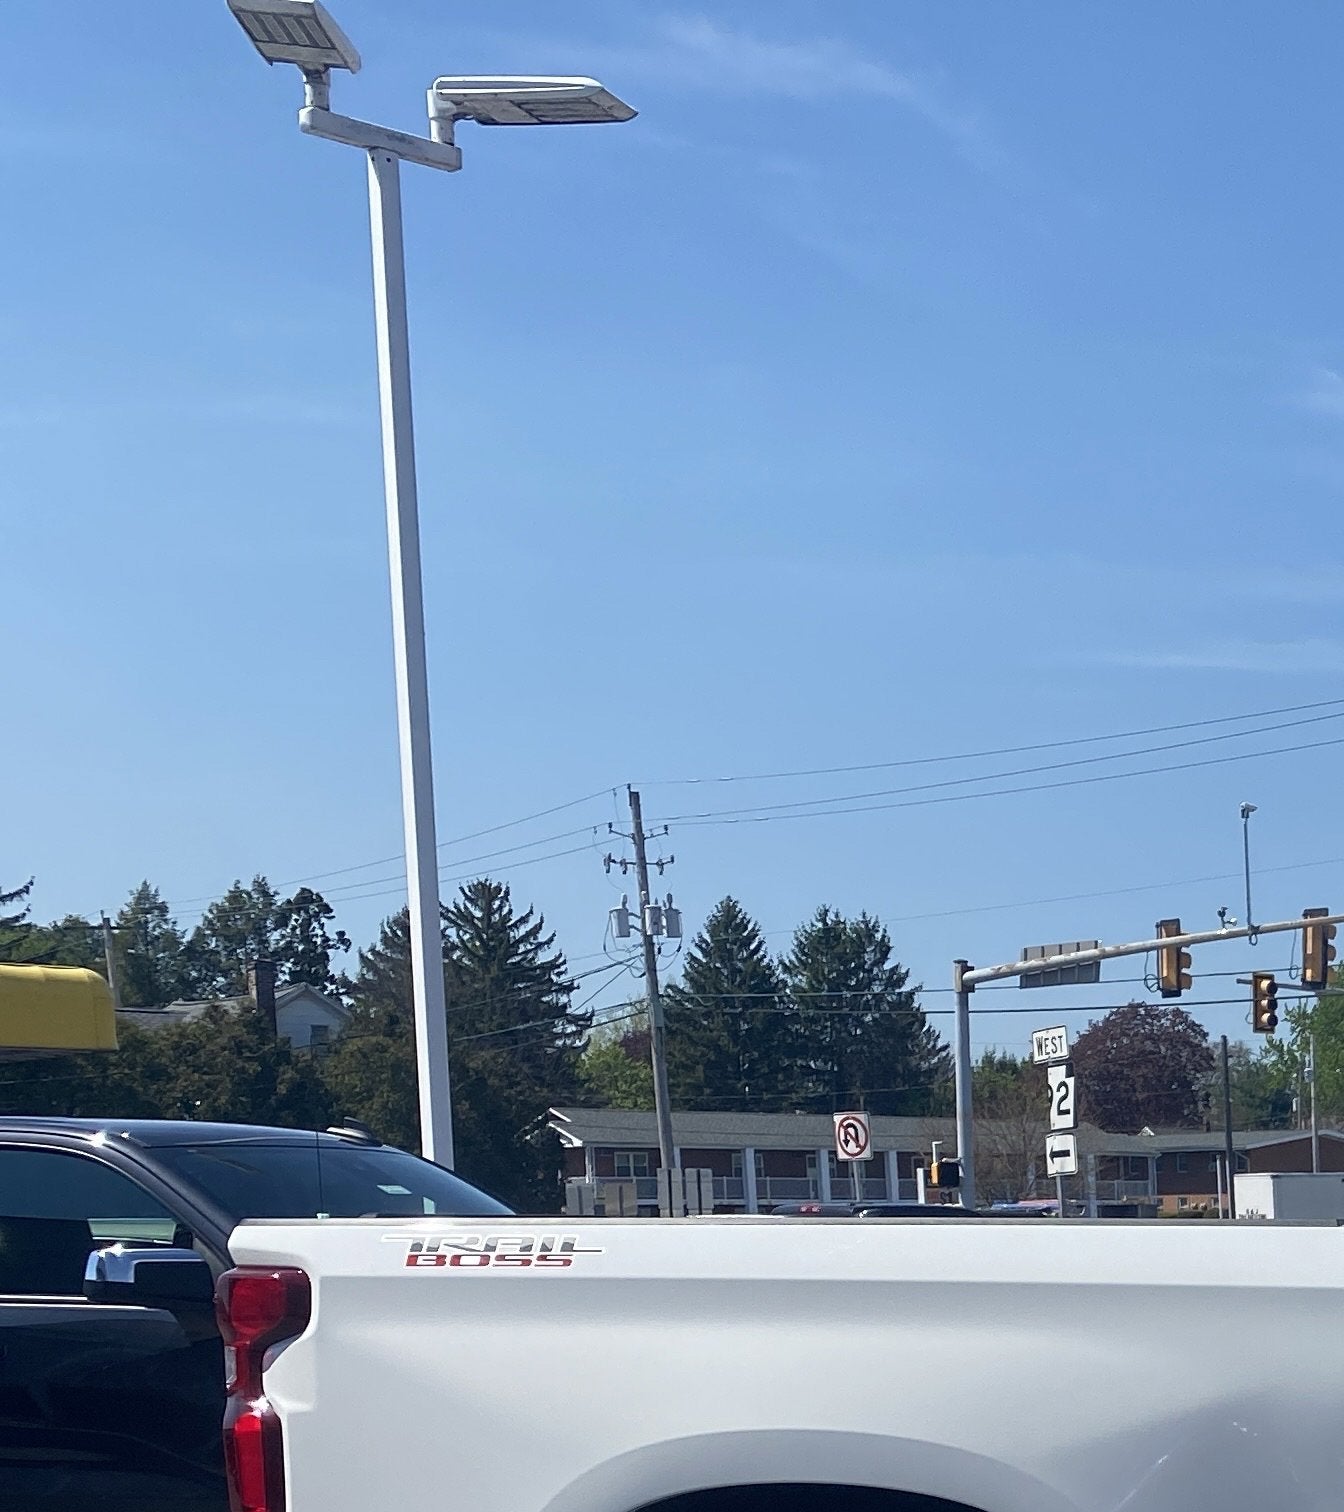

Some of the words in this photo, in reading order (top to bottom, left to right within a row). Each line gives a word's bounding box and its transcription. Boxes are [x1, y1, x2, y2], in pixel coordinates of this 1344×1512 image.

[1036, 1035, 1063, 1057] WEST
[383, 1235, 604, 1253] TRAIL
[405, 1254, 574, 1267] BOSS
